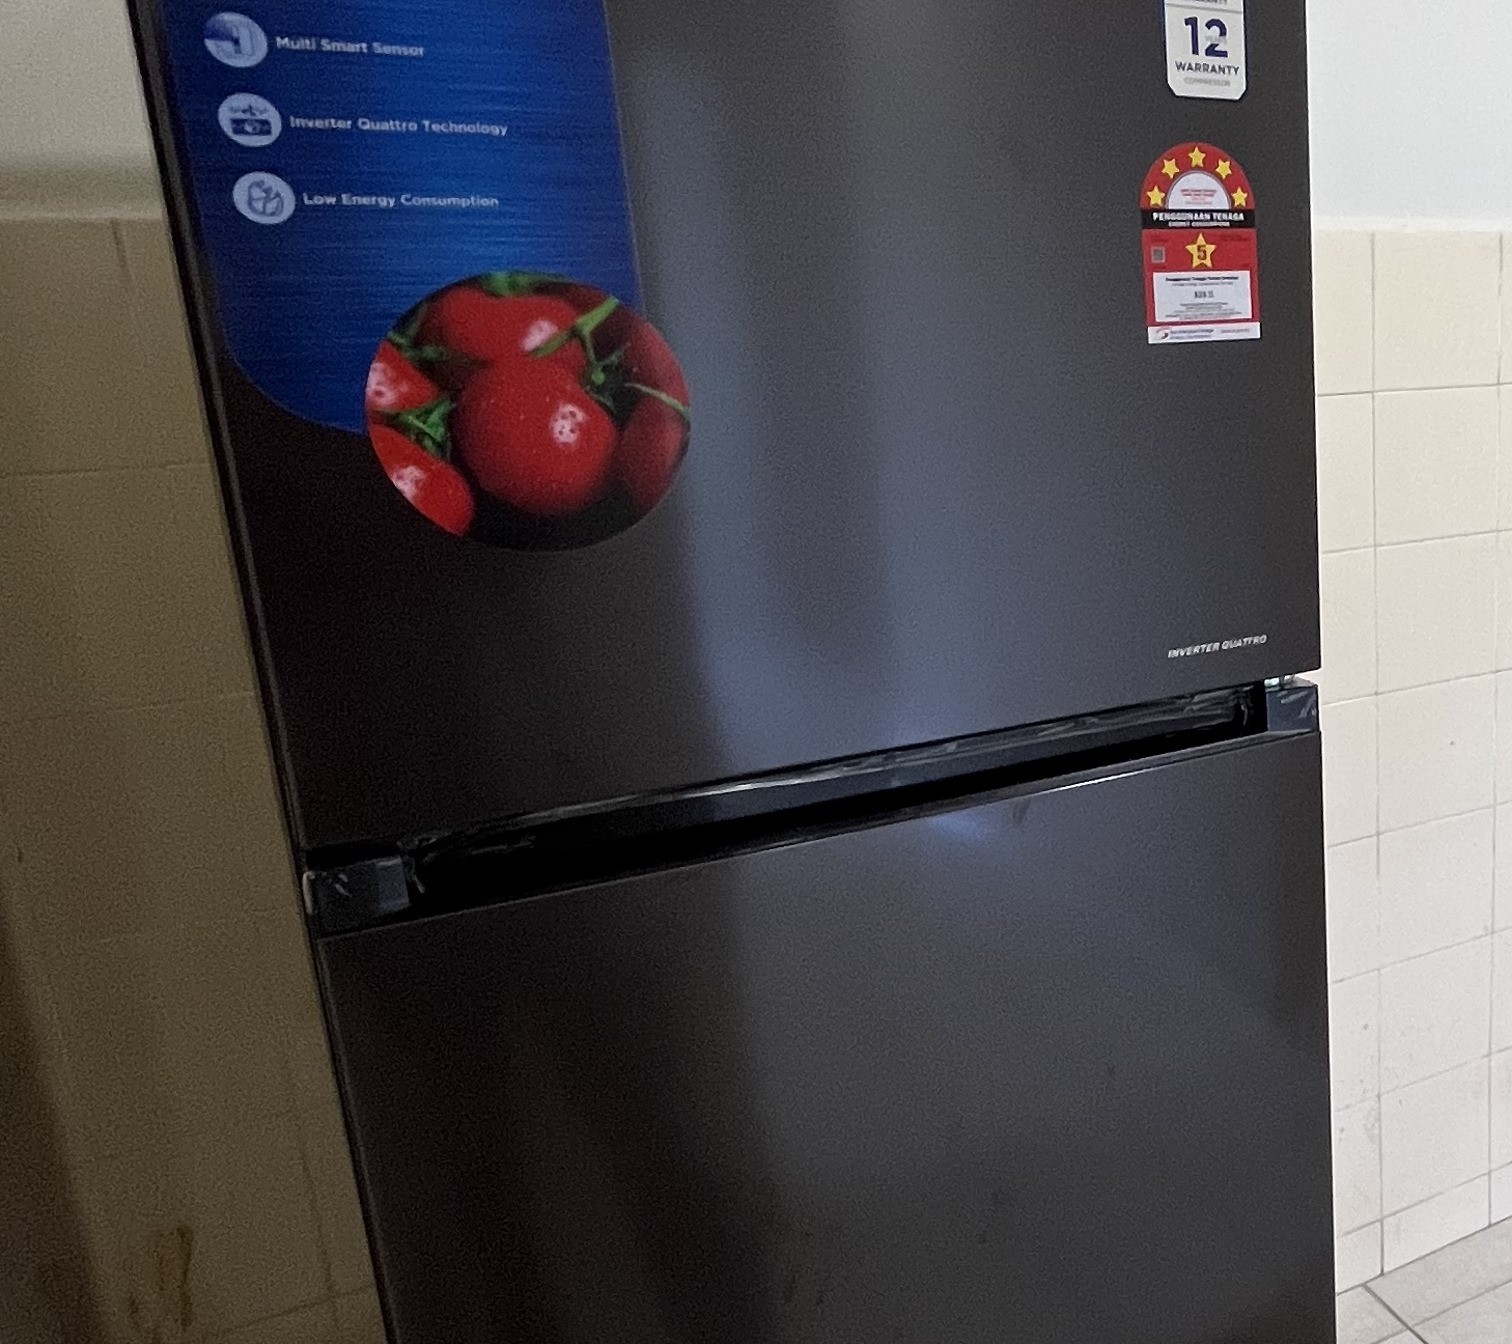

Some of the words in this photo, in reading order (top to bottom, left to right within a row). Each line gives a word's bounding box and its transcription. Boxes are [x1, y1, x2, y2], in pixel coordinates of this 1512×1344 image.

[275, 36, 317, 50] Multi
[320, 39, 368, 54] Smart
[372, 42, 425, 57] Sensor
[1184, 16, 1229, 58] 12
[1175, 61, 1240, 76] WARRANTY
[289, 115, 352, 130] Inverter
[357, 118, 418, 133] Quattro
[422, 120, 509, 137] Technology
[303, 192, 337, 206] Low
[341, 193, 397, 208] Energy
[400, 194, 499, 208] Consumption
[1167, 642, 1220, 658] INVERTER
[1221, 634, 1267, 649] QUATTRO
